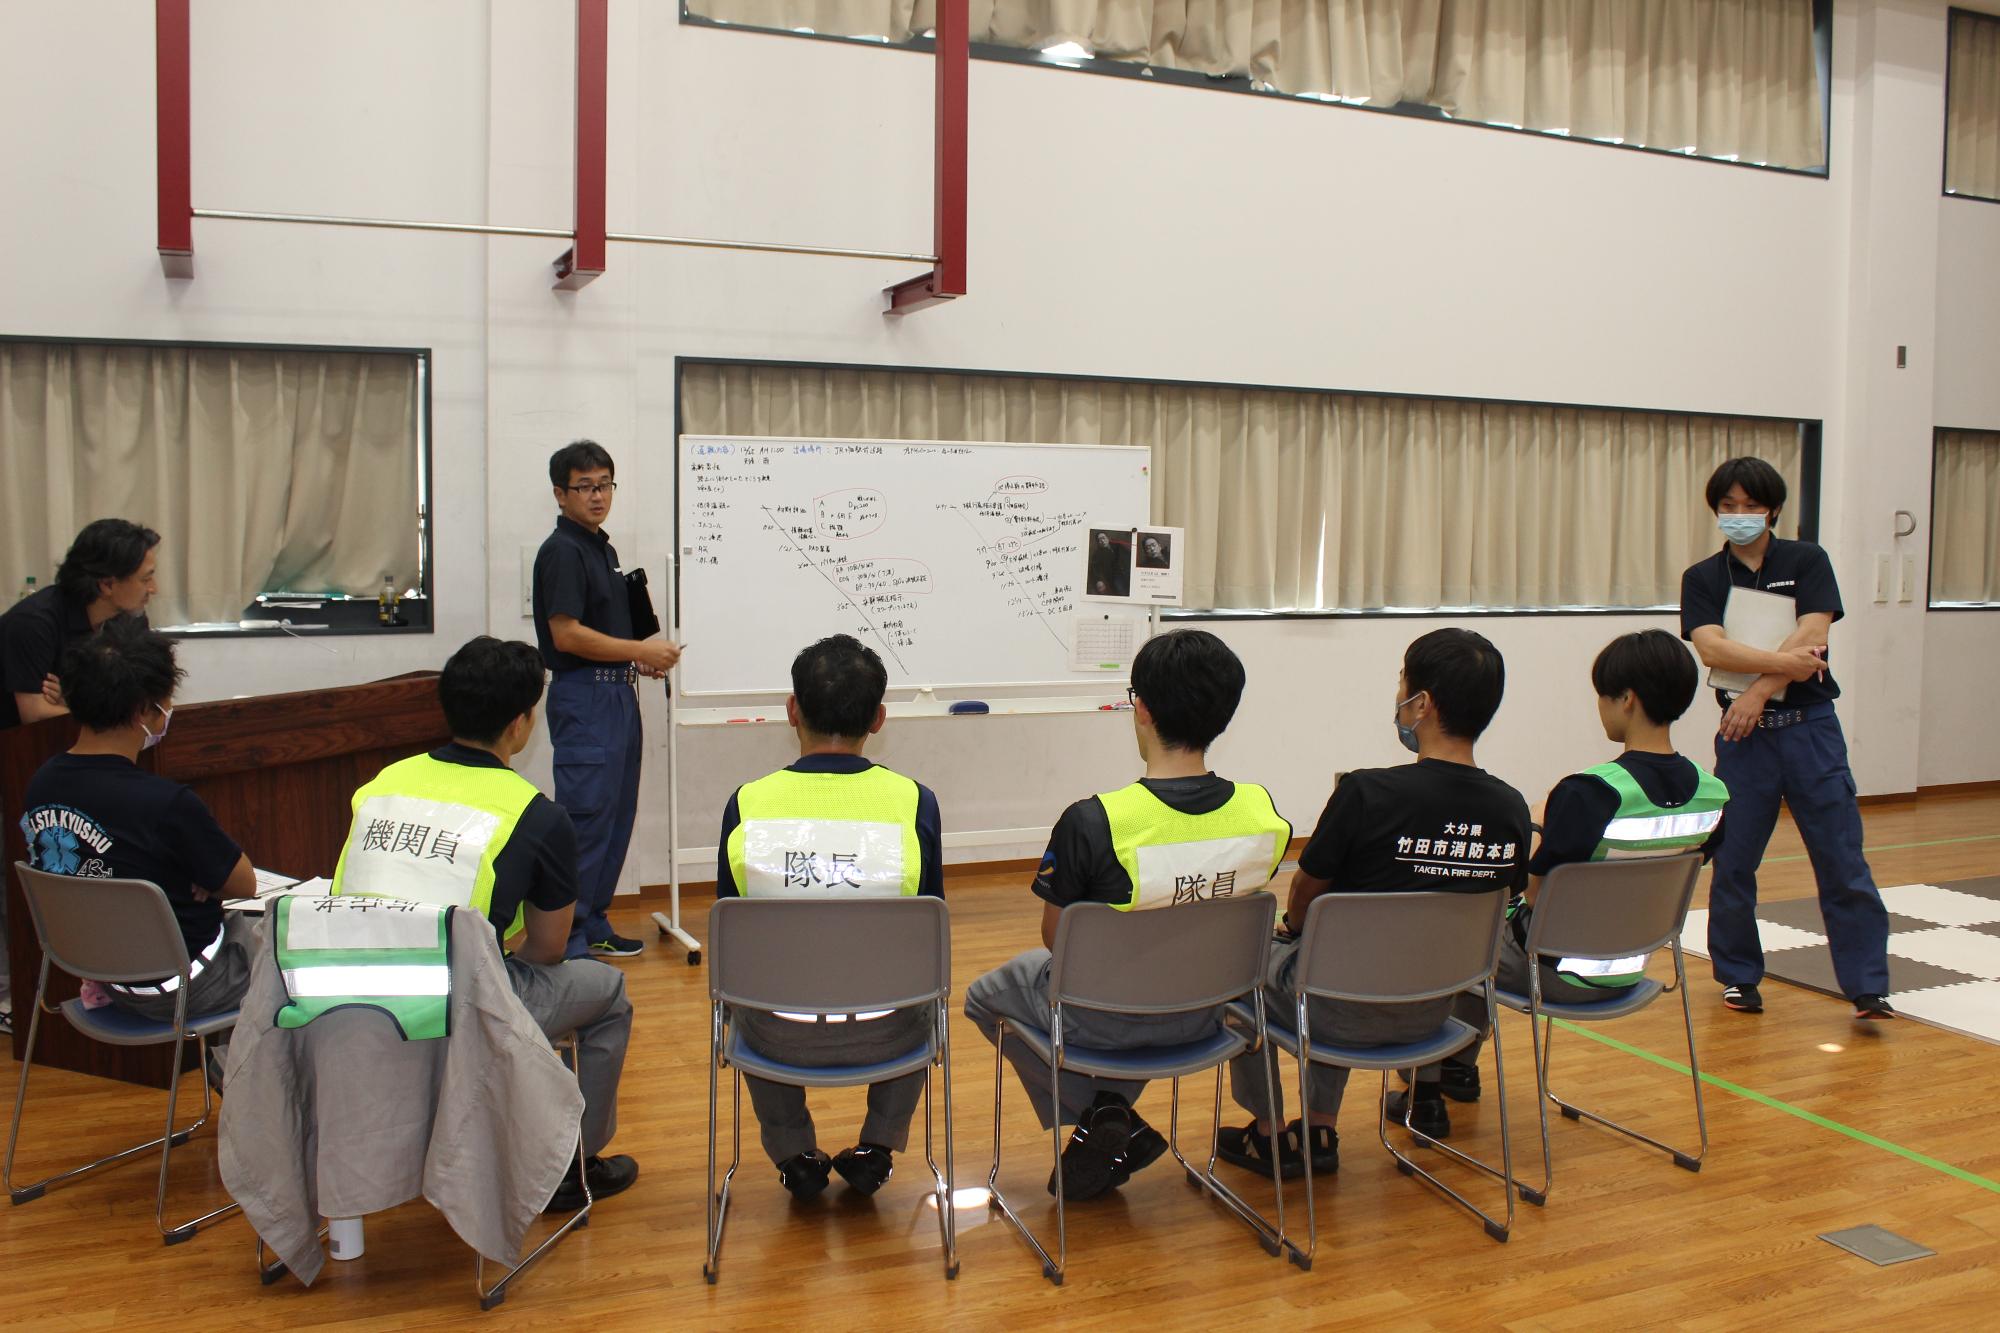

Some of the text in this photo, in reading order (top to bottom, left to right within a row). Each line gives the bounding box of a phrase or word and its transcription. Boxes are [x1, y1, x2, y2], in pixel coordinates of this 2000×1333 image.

[60, 809, 113, 854] KYUSHU
[362, 818, 462, 865] 機関員
[1443, 822, 1483, 837] 大分県
[1397, 836, 1517, 860] 竹田市消防本部
[784, 851, 862, 889] 隊長
[1171, 870, 1237, 906] 隊員
[1413, 864, 1497, 879] TAKETA FIRE DEPT.
